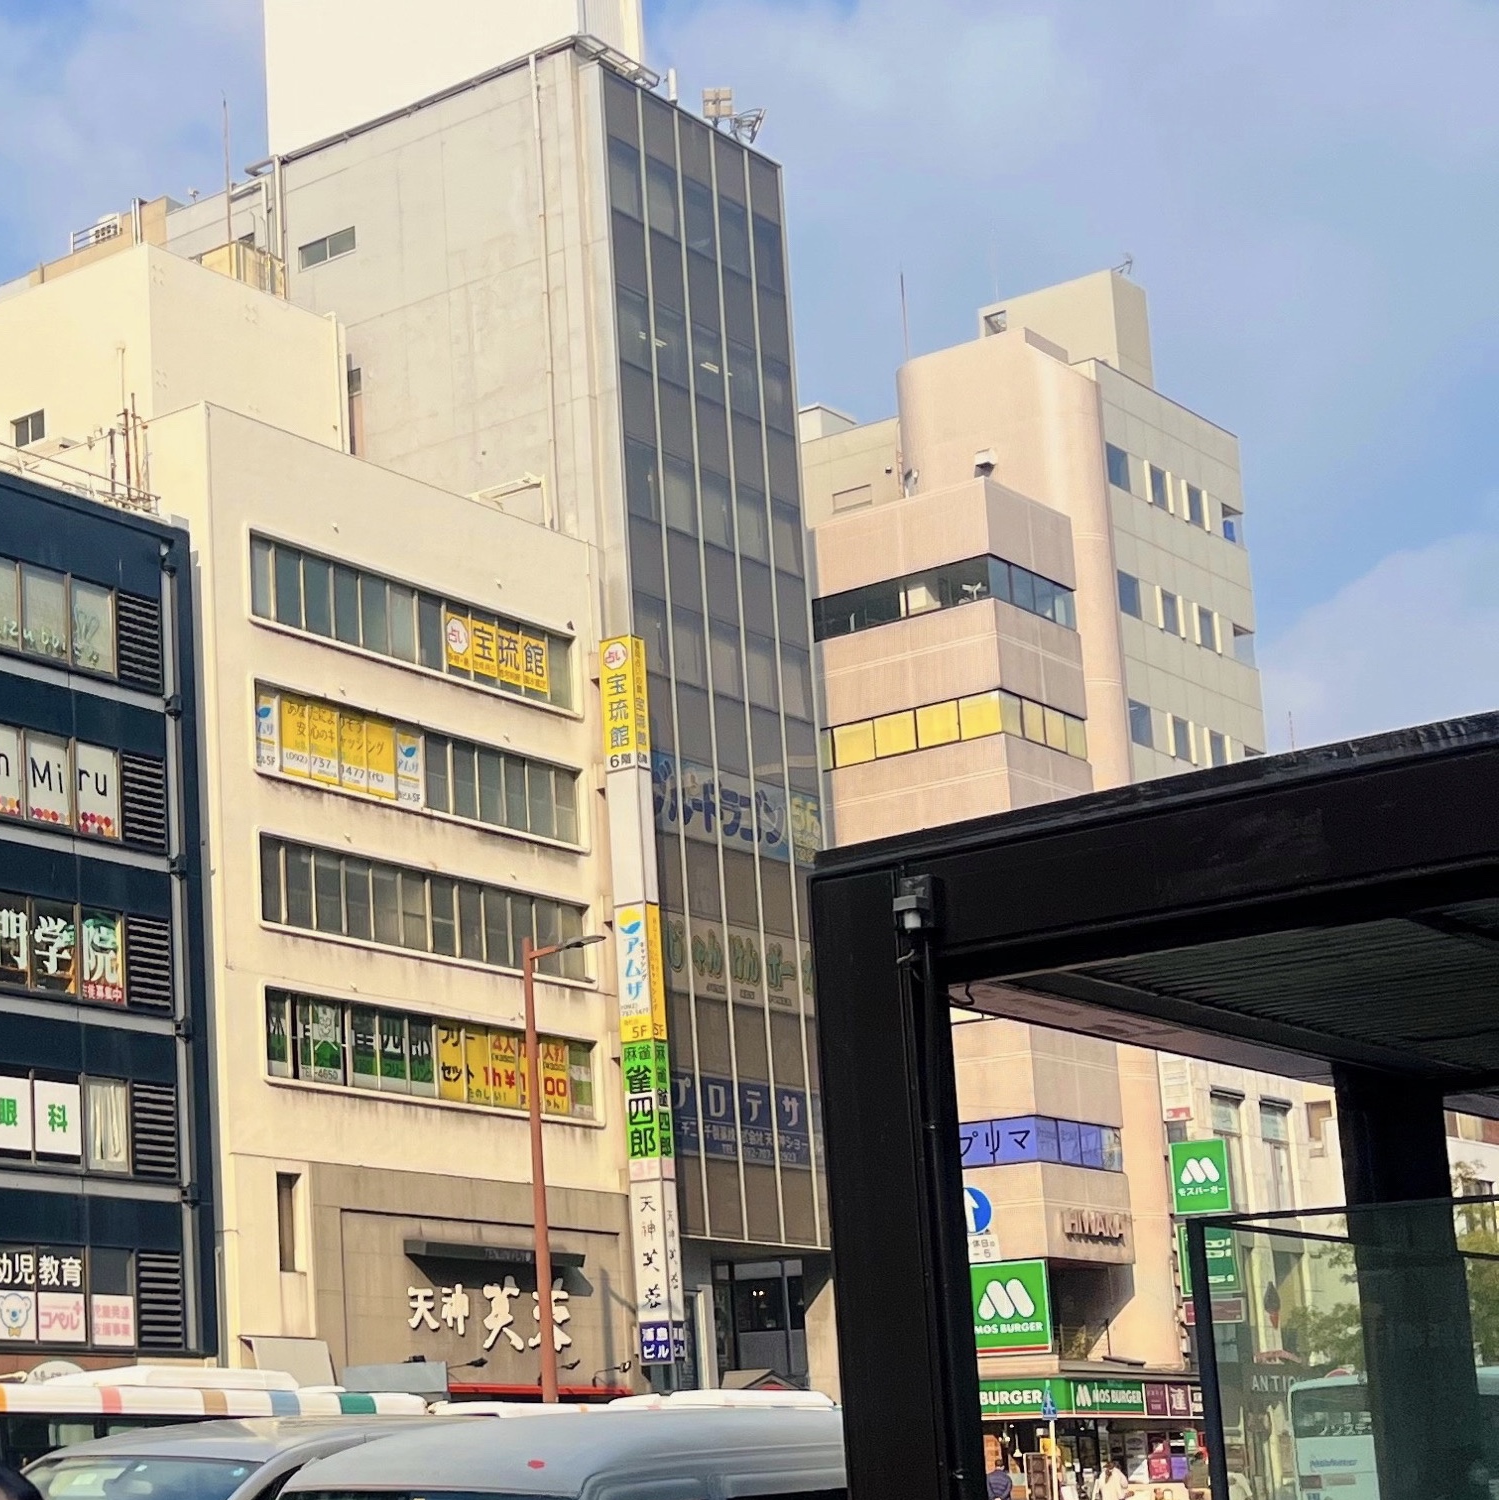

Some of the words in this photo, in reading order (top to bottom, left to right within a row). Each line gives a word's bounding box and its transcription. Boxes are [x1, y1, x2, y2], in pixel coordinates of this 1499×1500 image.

[473, 626, 545, 678] 宝琉館
[606, 673, 630, 749] 宝琉館
[30, 757, 107, 797] Miru
[624, 937, 643, 1001] アムザ
[632, 1025, 647, 1039] 5F
[624, 1044, 652, 1061] 麻雀
[441, 1061, 475, 1085] セット
[626, 1065, 656, 1157] 雀四郎
[1177, 1185, 1226, 1196] モスバーガー
[974, 1324, 999, 1335] MOS
[1001, 1322, 1044, 1334] BURGER
[643, 1344, 669, 1360] ビル
[980, 1389, 1043, 1406] BURGER
[1111, 1388, 1142, 1404] BURGER
